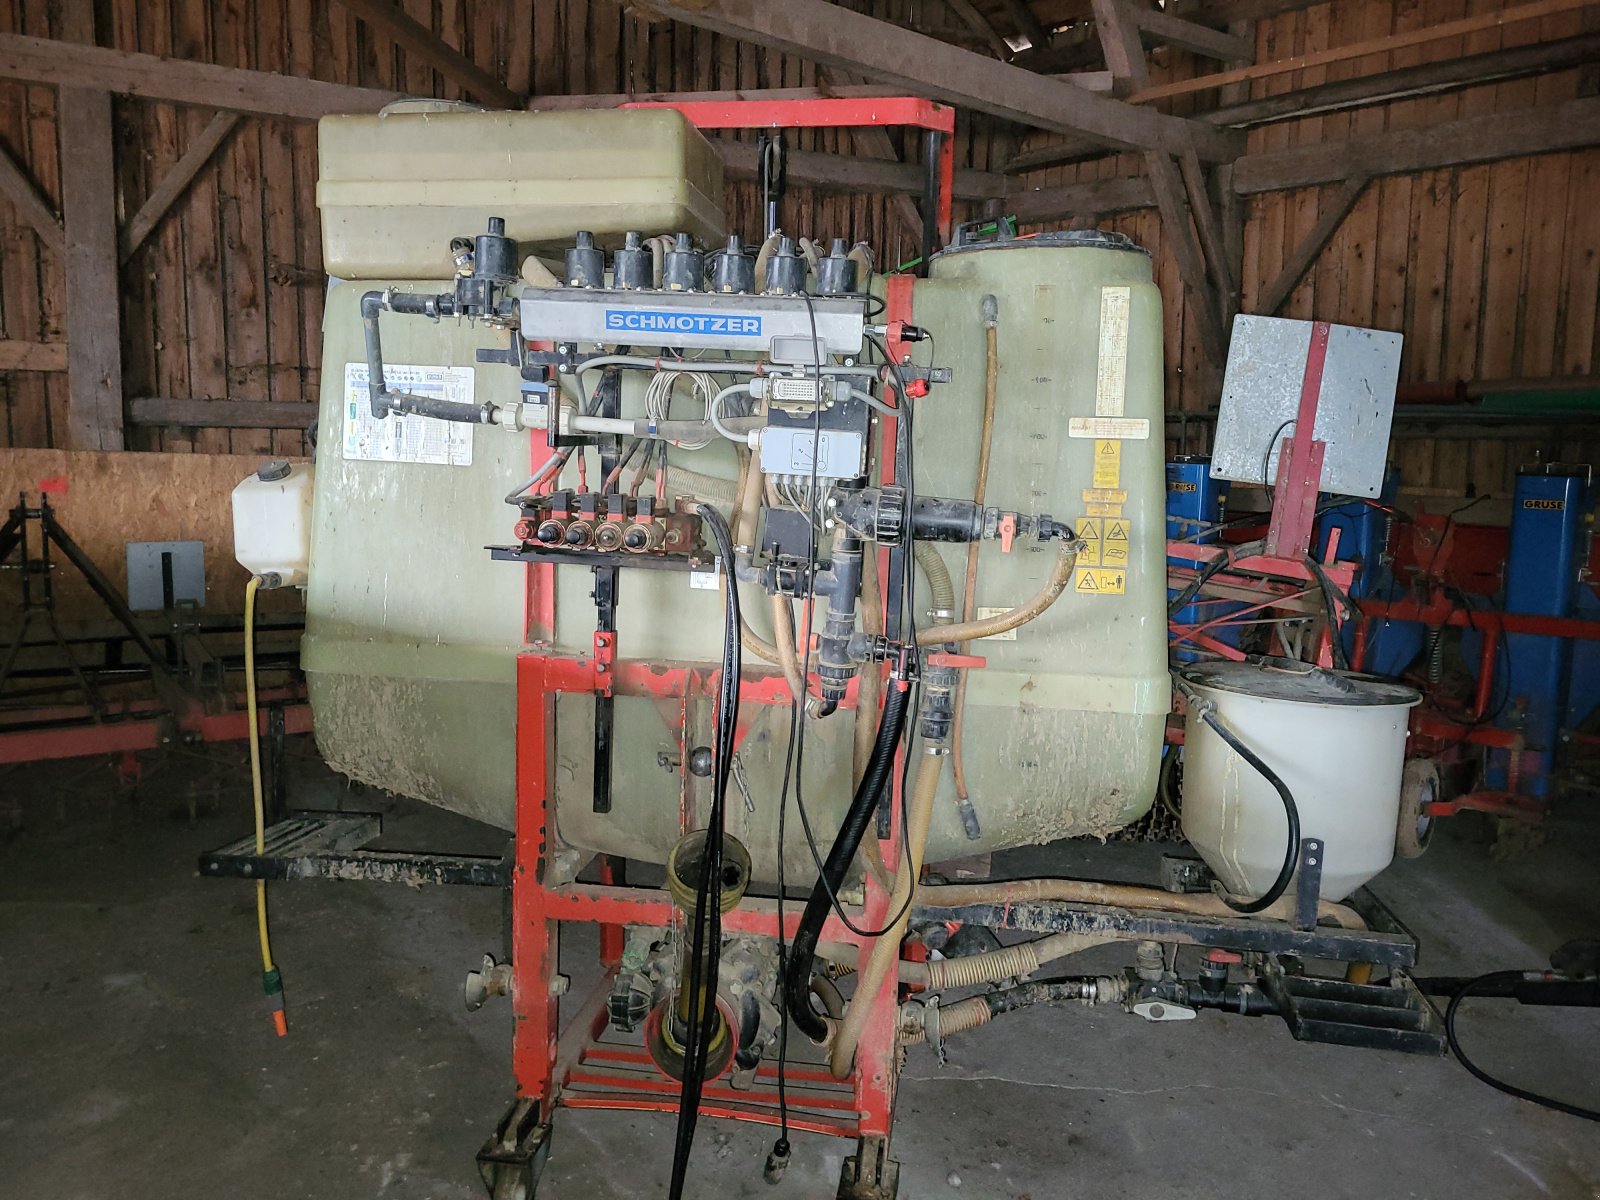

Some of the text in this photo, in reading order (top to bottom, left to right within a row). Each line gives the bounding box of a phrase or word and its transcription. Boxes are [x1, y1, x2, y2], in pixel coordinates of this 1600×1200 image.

[608, 313, 759, 333] SCHMOTZER
[1168, 483, 1195, 491] RSE
[1524, 500, 1563, 509] GRUSE
